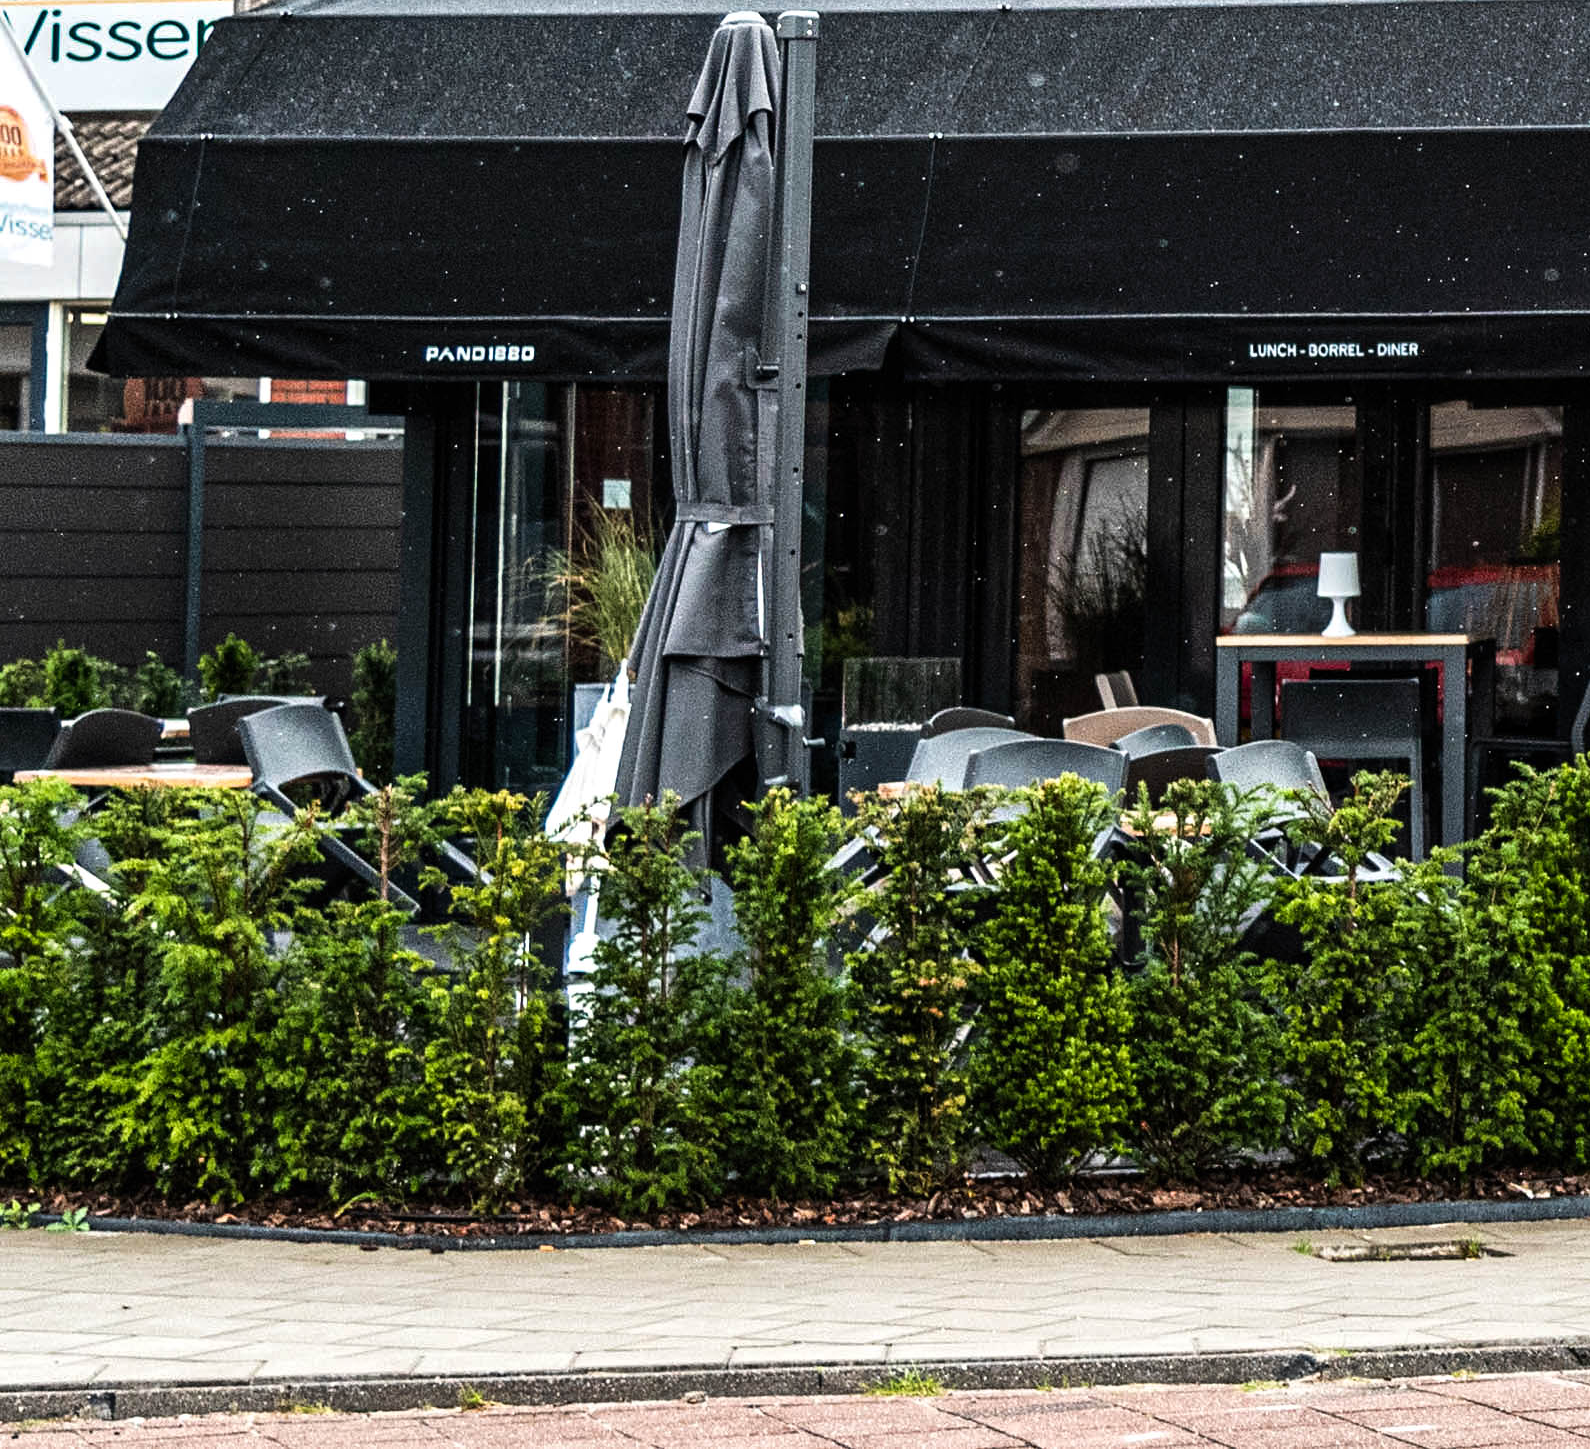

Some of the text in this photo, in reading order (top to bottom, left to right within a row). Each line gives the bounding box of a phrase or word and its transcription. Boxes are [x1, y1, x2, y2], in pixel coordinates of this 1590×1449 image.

[425, 345, 535, 362] PAND1880
[1249, 343, 1297, 357] LUNCH
[1308, 343, 1364, 357] BORREL
[1377, 342, 1419, 356] DINER
